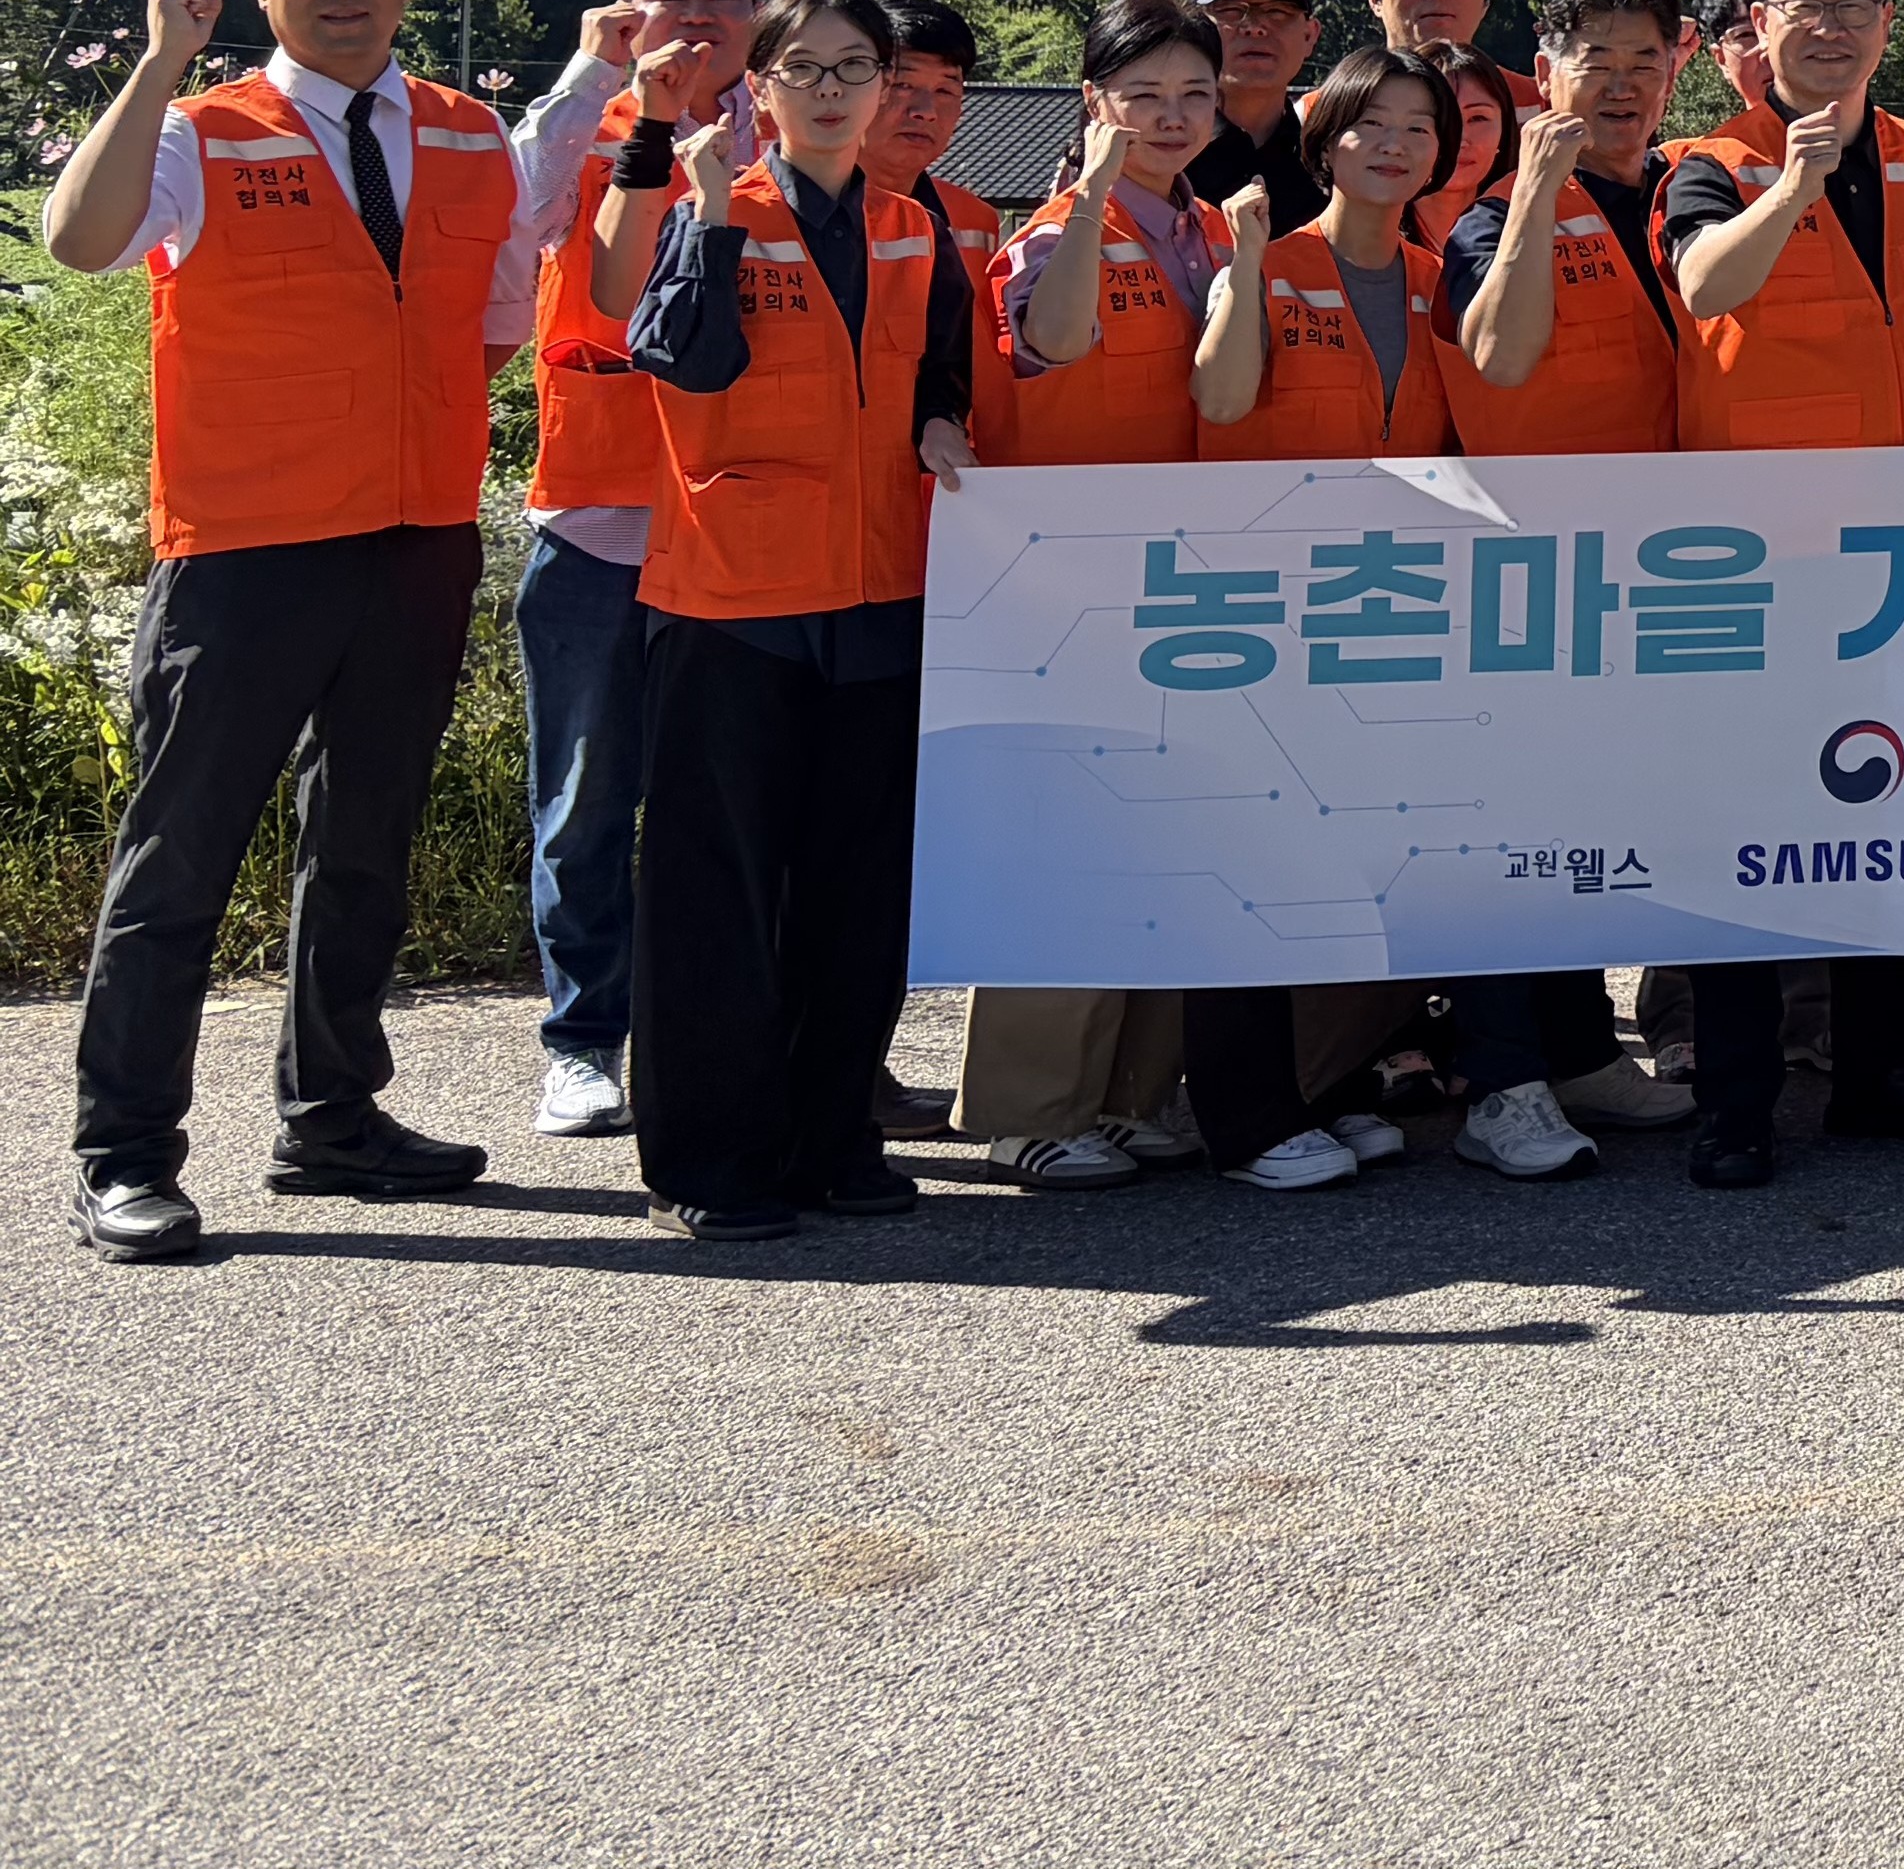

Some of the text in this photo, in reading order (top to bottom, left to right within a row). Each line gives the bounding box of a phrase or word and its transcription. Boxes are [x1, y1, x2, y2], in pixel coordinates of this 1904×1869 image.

[233, 163, 305, 185] 가전사
[235, 188, 311, 210] 협의체
[1553, 237, 1607, 261] 가전사
[737, 266, 803, 289] 가전사
[1560, 260, 1617, 284] 협의체
[740, 292, 808, 314] 협의체
[1282, 304, 1342, 330] 가전사
[1283, 327, 1345, 350] 협의체
[1133, 526, 1773, 690] 농촌마을
[1504, 847, 1653, 894] 교원 웰스
